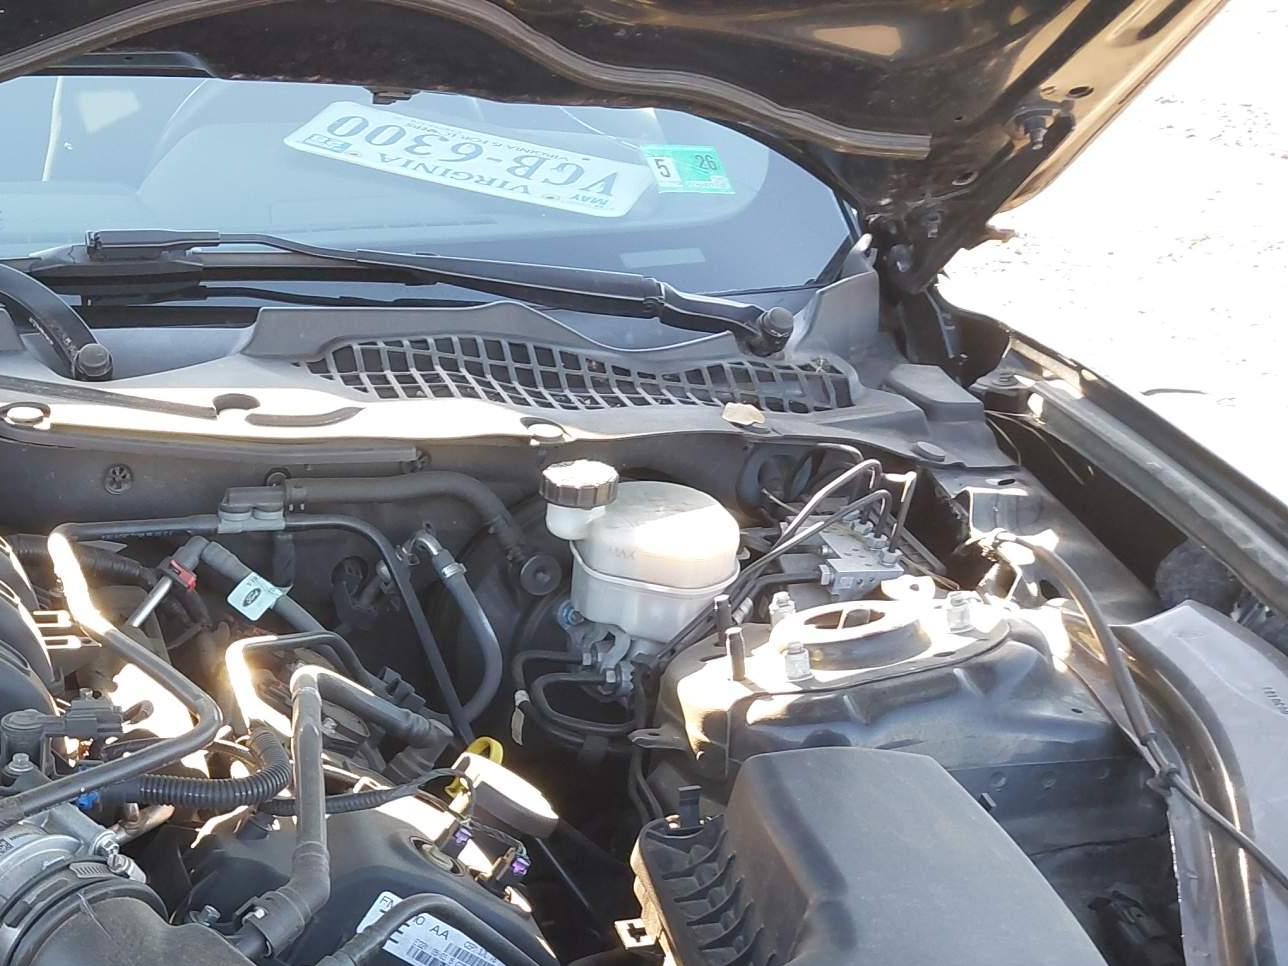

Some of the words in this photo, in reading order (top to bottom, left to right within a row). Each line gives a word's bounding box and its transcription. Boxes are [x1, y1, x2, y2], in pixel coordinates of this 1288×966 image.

[654, 158, 671, 178] 5
[695, 155, 717, 170] 26
[376, 152, 534, 195] VIRGINIA
